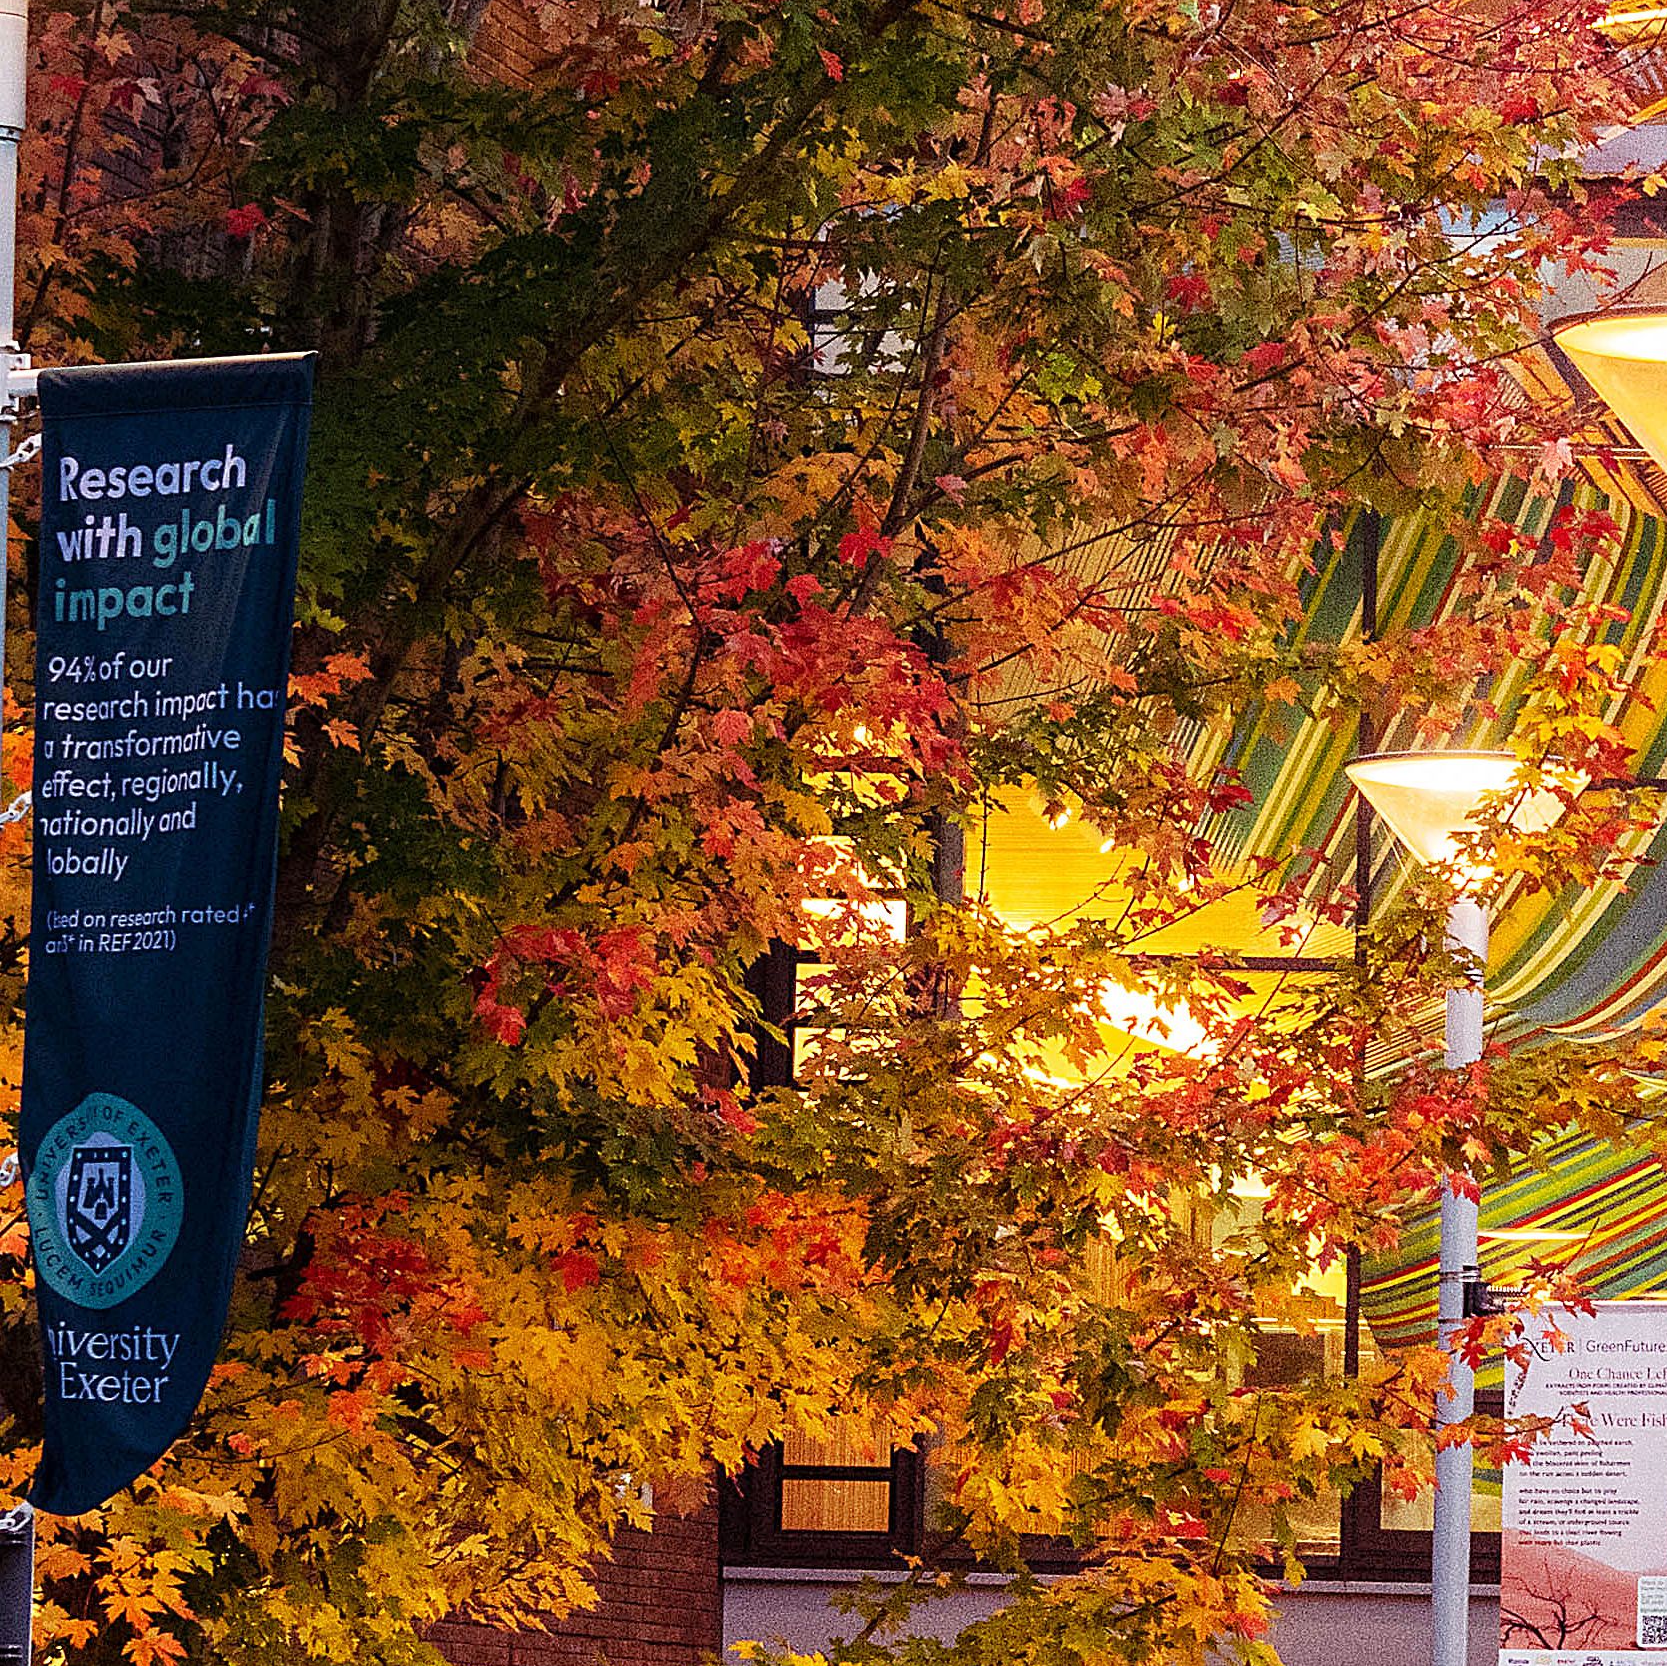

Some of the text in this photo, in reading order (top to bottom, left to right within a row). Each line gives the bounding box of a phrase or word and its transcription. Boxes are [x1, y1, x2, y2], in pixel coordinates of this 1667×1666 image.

[60, 444, 246, 501] Research
[56, 499, 276, 568] with global
[55, 571, 194, 630] impact
[48, 652, 173, 683] 94% of our
[43, 690, 148, 722] research
[155, 683, 229, 721] impact
[62, 723, 242, 760] transformative
[41, 761, 244, 802] effect, regionally,
[159, 801, 197, 832] and
[47, 847, 129, 882] lobally
[83, 905, 240, 928] on research rated
[78, 929, 176, 952] in REF 2021)
[60, 1361, 170, 1404] Exeter
[1568, 1367, 1594, 1381] One
[1596, 1367, 1645, 1381] Chance
[1601, 1413, 1637, 1427] Were
